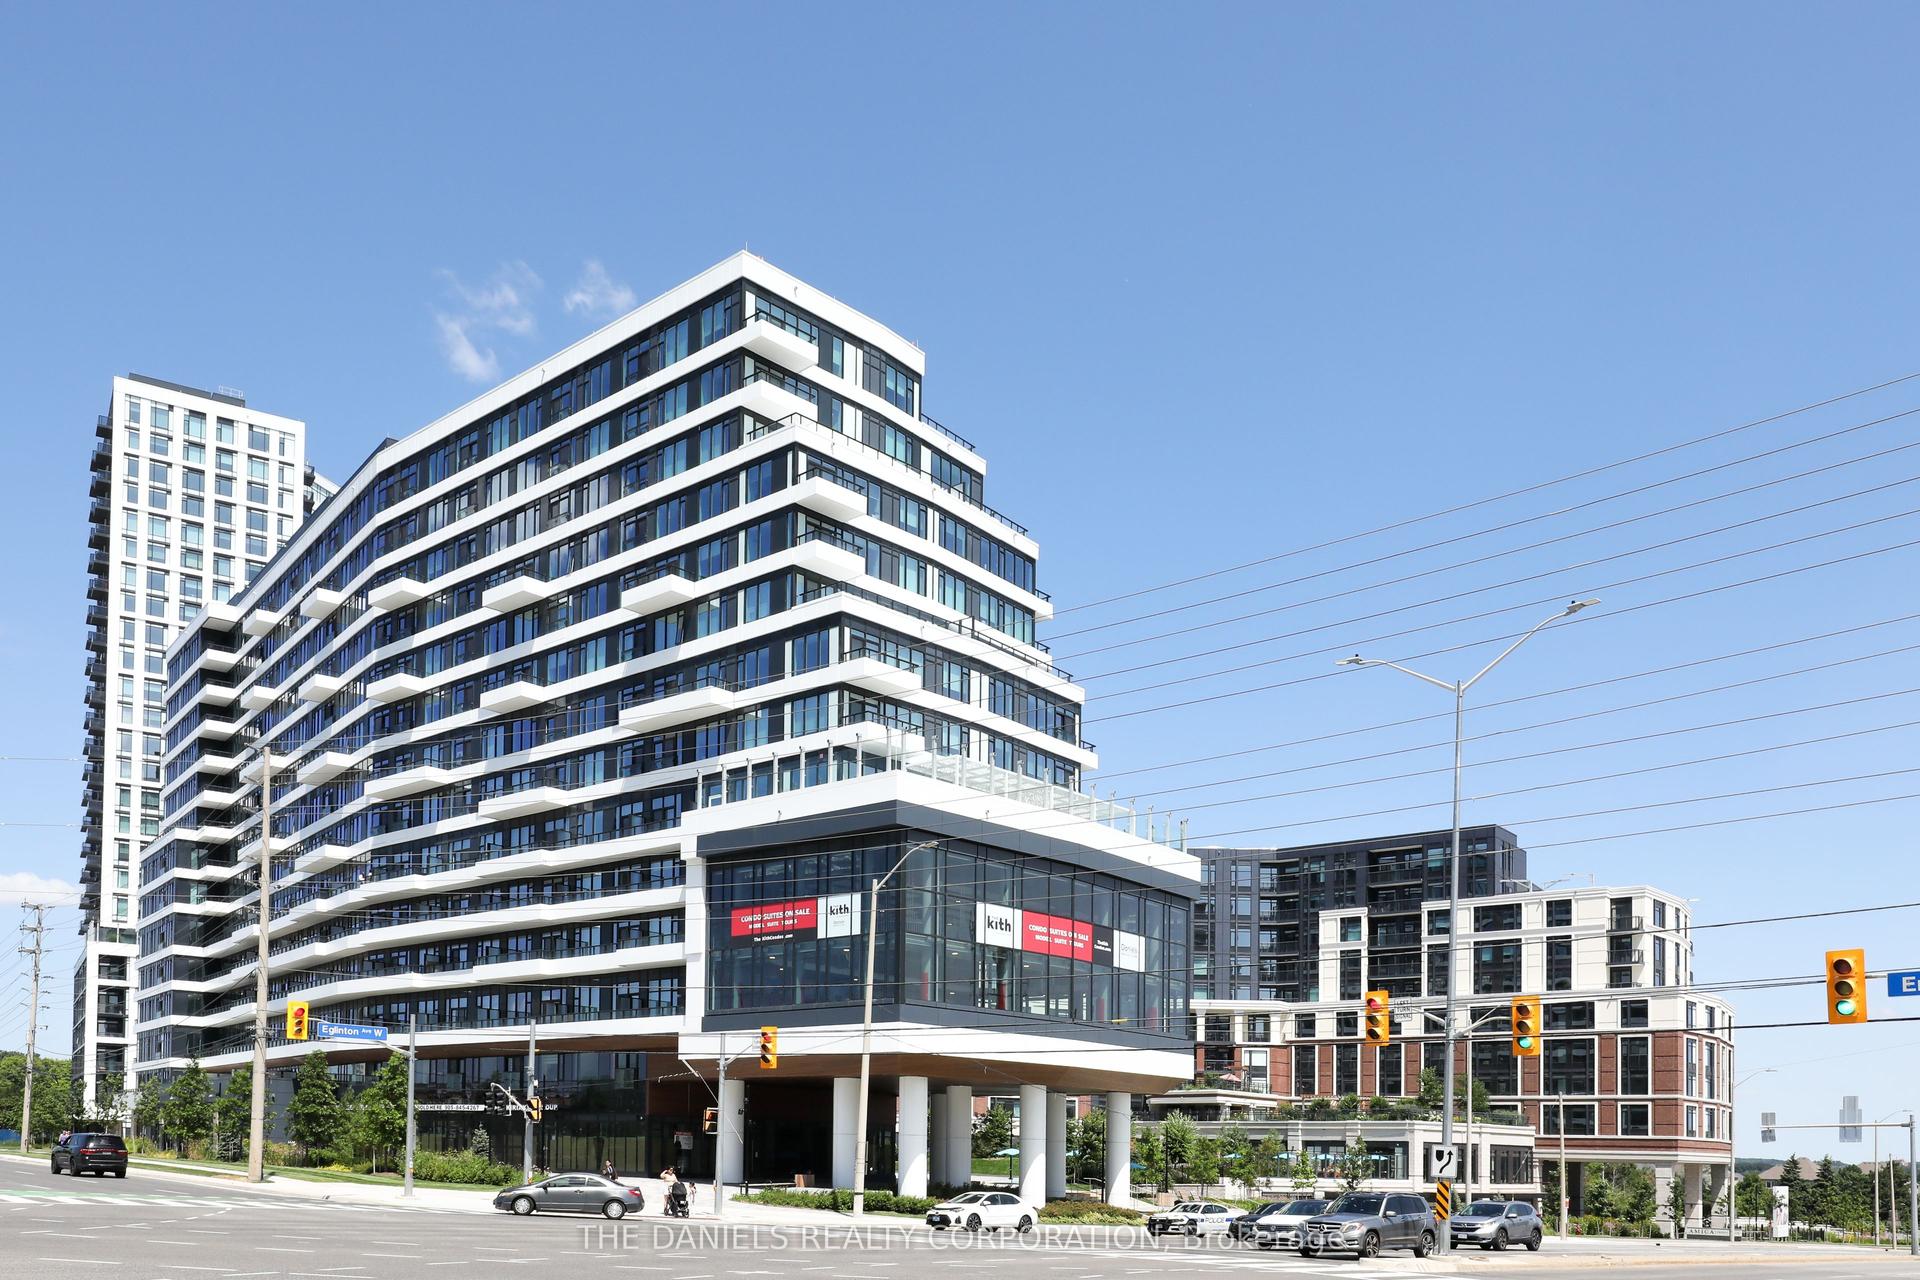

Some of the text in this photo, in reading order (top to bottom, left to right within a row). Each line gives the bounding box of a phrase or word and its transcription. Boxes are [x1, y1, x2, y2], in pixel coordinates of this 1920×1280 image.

[830, 904, 849, 915] kith
[741, 915, 762, 923] CONDO
[763, 912, 784, 920] SUITES
[785, 910, 794, 918] ON
[987, 915, 1011, 932] kith
[1029, 925, 1048, 933] CONDO
[1050, 928, 1068, 937] SUITES
[1078, 933, 1089, 941] SALE
[321, 1025, 359, 1036] Eglinton
[374, 1028, 383, 1037] W
